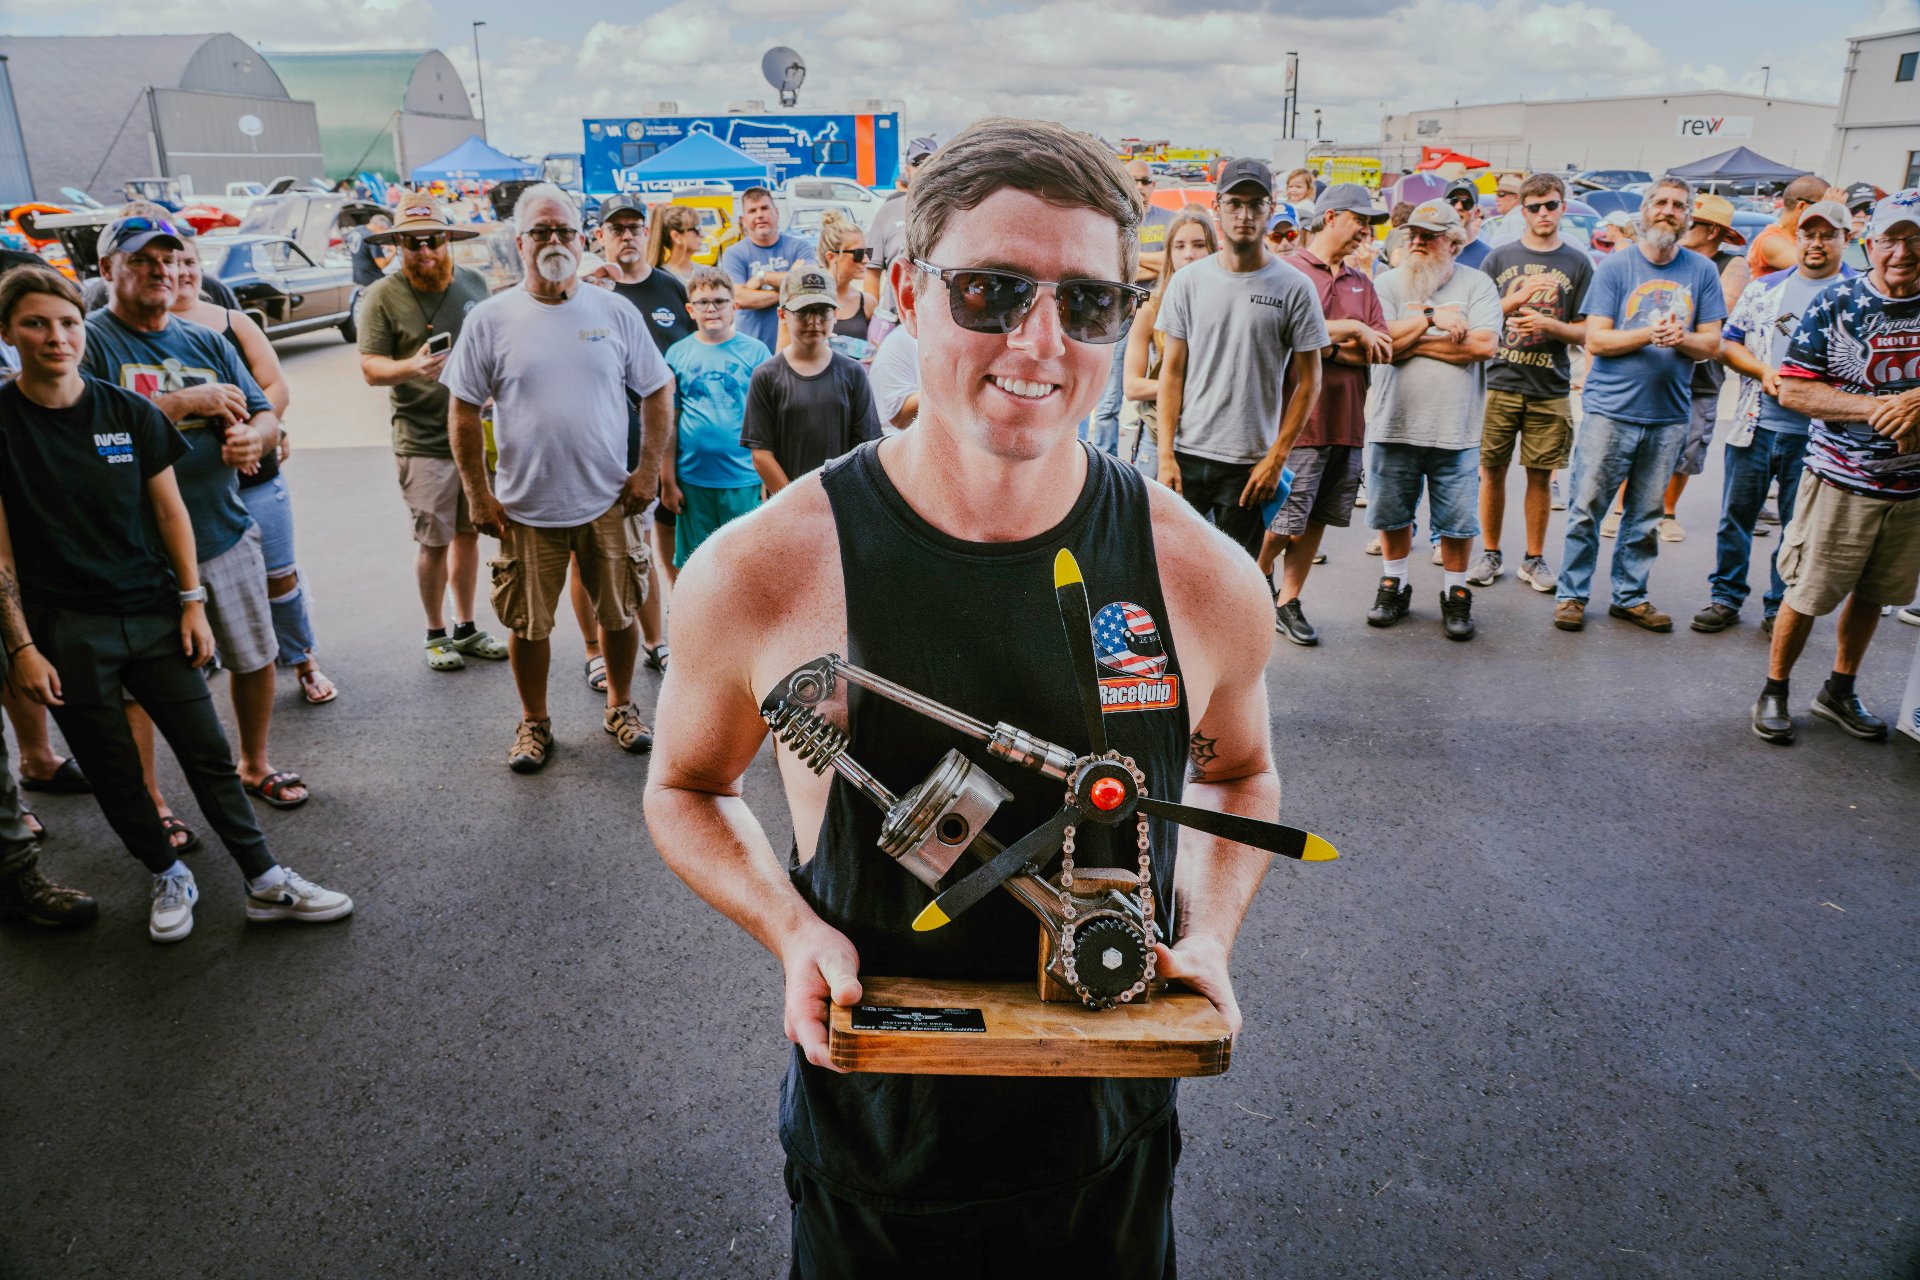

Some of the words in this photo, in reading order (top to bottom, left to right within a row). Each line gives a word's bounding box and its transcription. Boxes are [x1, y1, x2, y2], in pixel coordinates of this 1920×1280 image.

[1495, 265, 1520, 288] JUST
[1523, 263, 1547, 275] ONE
[1550, 267, 1574, 294] MORE
[1250, 294, 1283, 309] WILLIAM
[93, 432, 133, 447] NASA
[107, 453, 134, 464] 2023
[1099, 680, 1171, 705] RaceQuip
